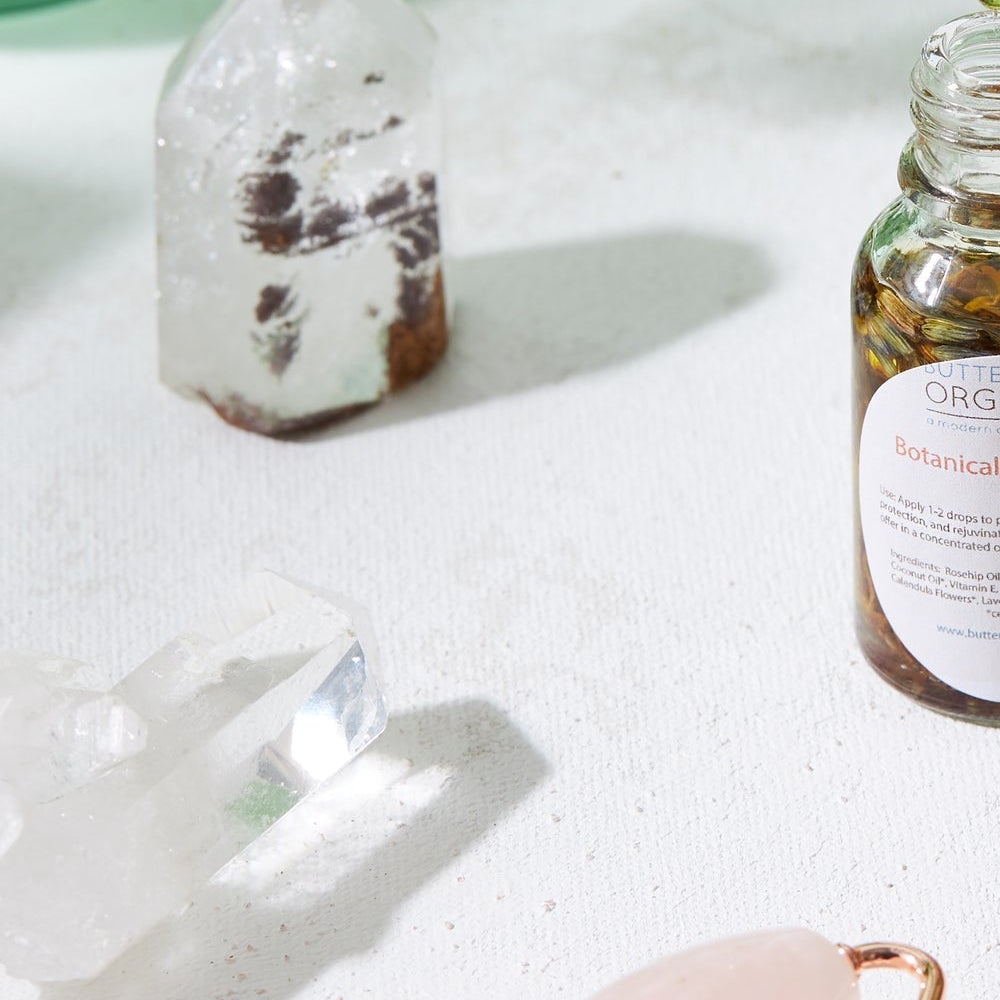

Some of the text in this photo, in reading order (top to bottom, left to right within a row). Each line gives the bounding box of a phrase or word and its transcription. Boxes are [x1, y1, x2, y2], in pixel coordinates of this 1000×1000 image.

[926, 417, 935, 426] a
[937, 419, 993, 435] modern
[894, 434, 1000, 477] Botanical
[879, 483, 897, 501] Use:
[898, 495, 926, 515] Apply
[929, 505, 944, 518] 1-2
[946, 510, 978, 525] drops
[981, 515, 993, 525] to
[879, 500, 928, 529] protection,
[930, 521, 951, 533] and
[879, 514, 899, 530] offer
[901, 524, 910, 535] in
[920, 531, 991, 552] concentrated
[890, 548, 942, 574] Ingredients:
[945, 566, 984, 582] Rosehip
[891, 560, 926, 581] Coconut
[949, 580, 988, 594] Vitamin
[990, 585, 999, 594] E,
[890, 573, 933, 596] Calendula
